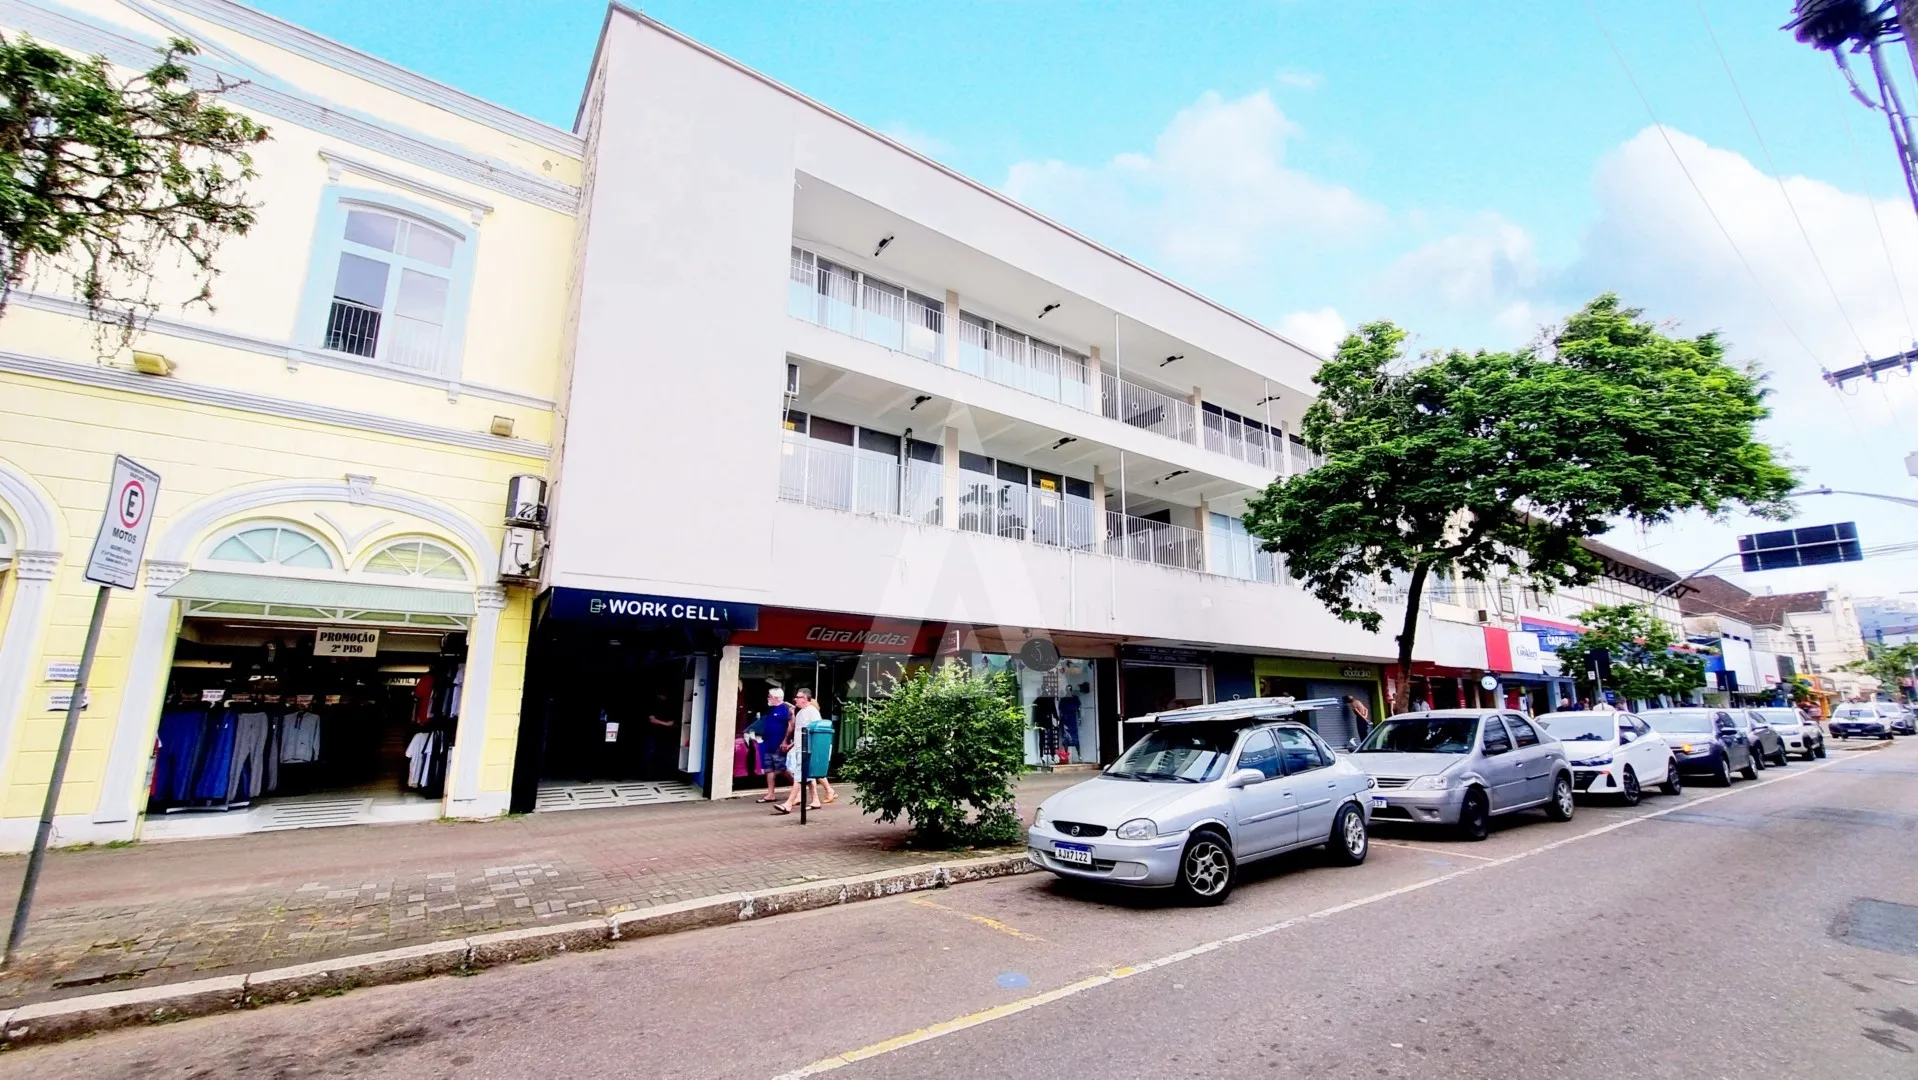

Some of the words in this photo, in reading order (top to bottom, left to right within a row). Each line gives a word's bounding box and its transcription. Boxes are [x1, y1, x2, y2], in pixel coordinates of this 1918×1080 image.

[126, 489, 139, 518] E
[112, 527, 137, 544] MOTOS
[609, 599, 667, 617] WORK
[671, 604, 719, 621] CELL
[320, 631, 376, 643] PROMOÇÃO
[806, 627, 852, 641] Clara
[852, 630, 910, 646] Modas
[343, 644, 363, 653] PISO
[1057, 848, 1088, 863] AJX7122
